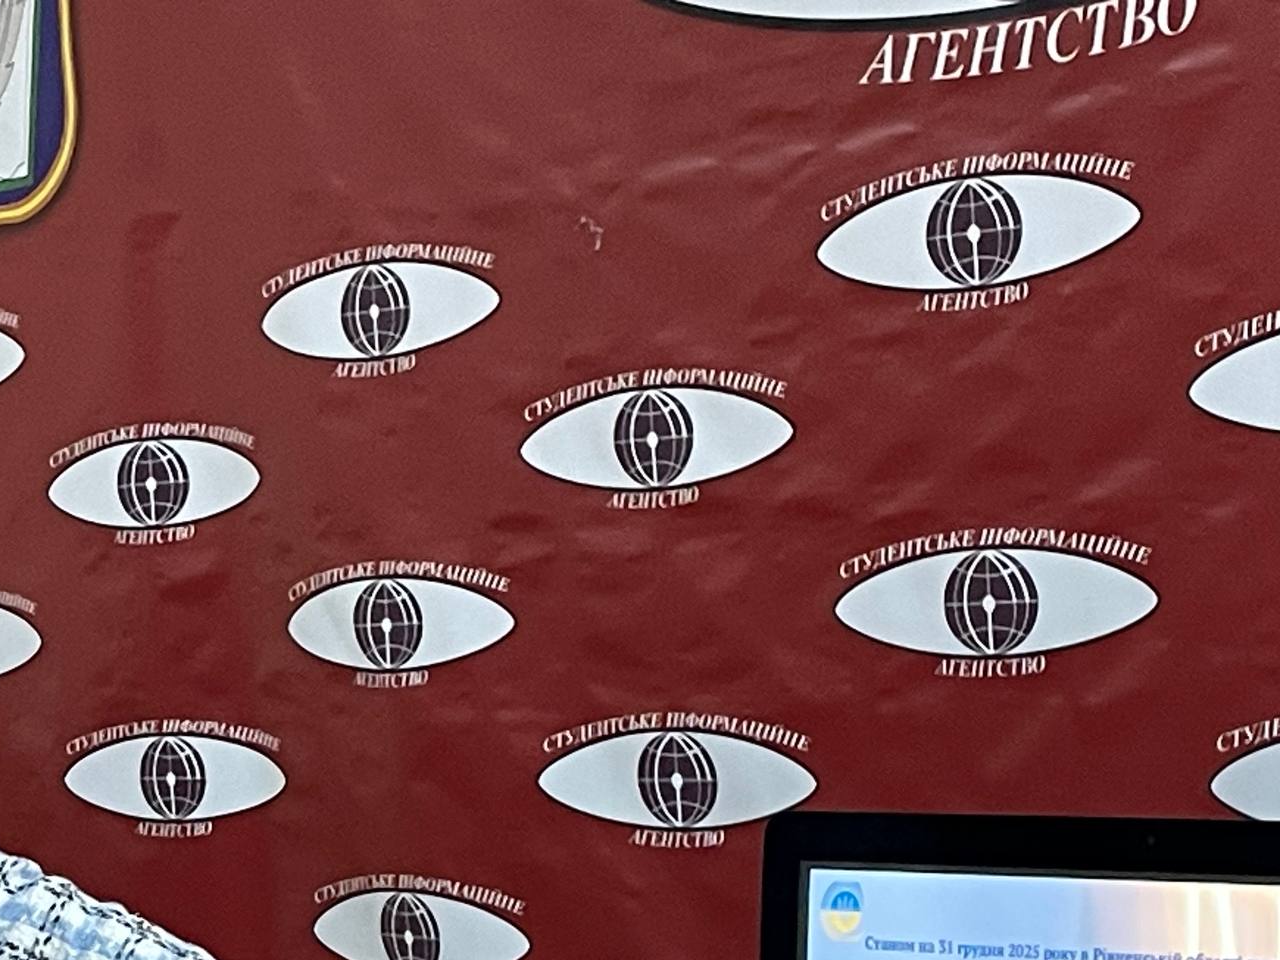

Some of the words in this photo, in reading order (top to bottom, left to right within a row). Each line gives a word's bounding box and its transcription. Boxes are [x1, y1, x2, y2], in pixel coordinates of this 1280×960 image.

[858, 0, 1199, 85] АГЕНТСТВО
[820, 158, 957, 222] СТУДЕНТСЬКЕ
[962, 152, 1136, 180] ІНФОРМАЦІЙНЕ
[261, 247, 362, 298] СТУДЕНТСЬКЕ
[366, 244, 495, 268] ІНФОРМАЦІЙНЕ
[917, 281, 1029, 312] АГЕНТСТВО
[331, 354, 416, 378] АГЕНТСТВО
[523, 371, 639, 422] СТУДЕНТСЬКЕ
[643, 368, 788, 398] ІНФОРМАЦІЙНЕ
[49, 423, 139, 468] СТУДЕНТСЬКЕ
[142, 423, 255, 449] ІНФОРМАЦІЙНЕ
[606, 486, 699, 509] АГЕНТСТВО
[115, 524, 195, 545] АГЕНТСТВО
[839, 529, 973, 578] СТУДЕНТСЬКЕ
[979, 528, 1152, 565] ІНФОРМАЦІЙНЕ
[288, 561, 375, 602] СТУДЕНТСЬКЕ
[379, 560, 510, 592] ІНФОРМАЦІЙНЕ
[353, 670, 428, 688] АГЕНТСТВО
[934, 655, 1047, 678] АГЕНТСТВО
[66, 720, 158, 754] СТУДЕНТСЬКЕ
[542, 713, 662, 752] СТУДЕНТСЬКЕ
[666, 712, 811, 750] ІНФОРМАЦІЙНЕ
[135, 821, 213, 838] АГЕНТСТВО
[629, 829, 725, 848] АГЕНТСТВО
[314, 874, 397, 904] СТУДЕНТСЬКЕ
[919, 941, 935, 954] на
[938, 940, 953, 955] 31
[957, 944, 1004, 959] грудня
[1008, 943, 1040, 958] 2025
